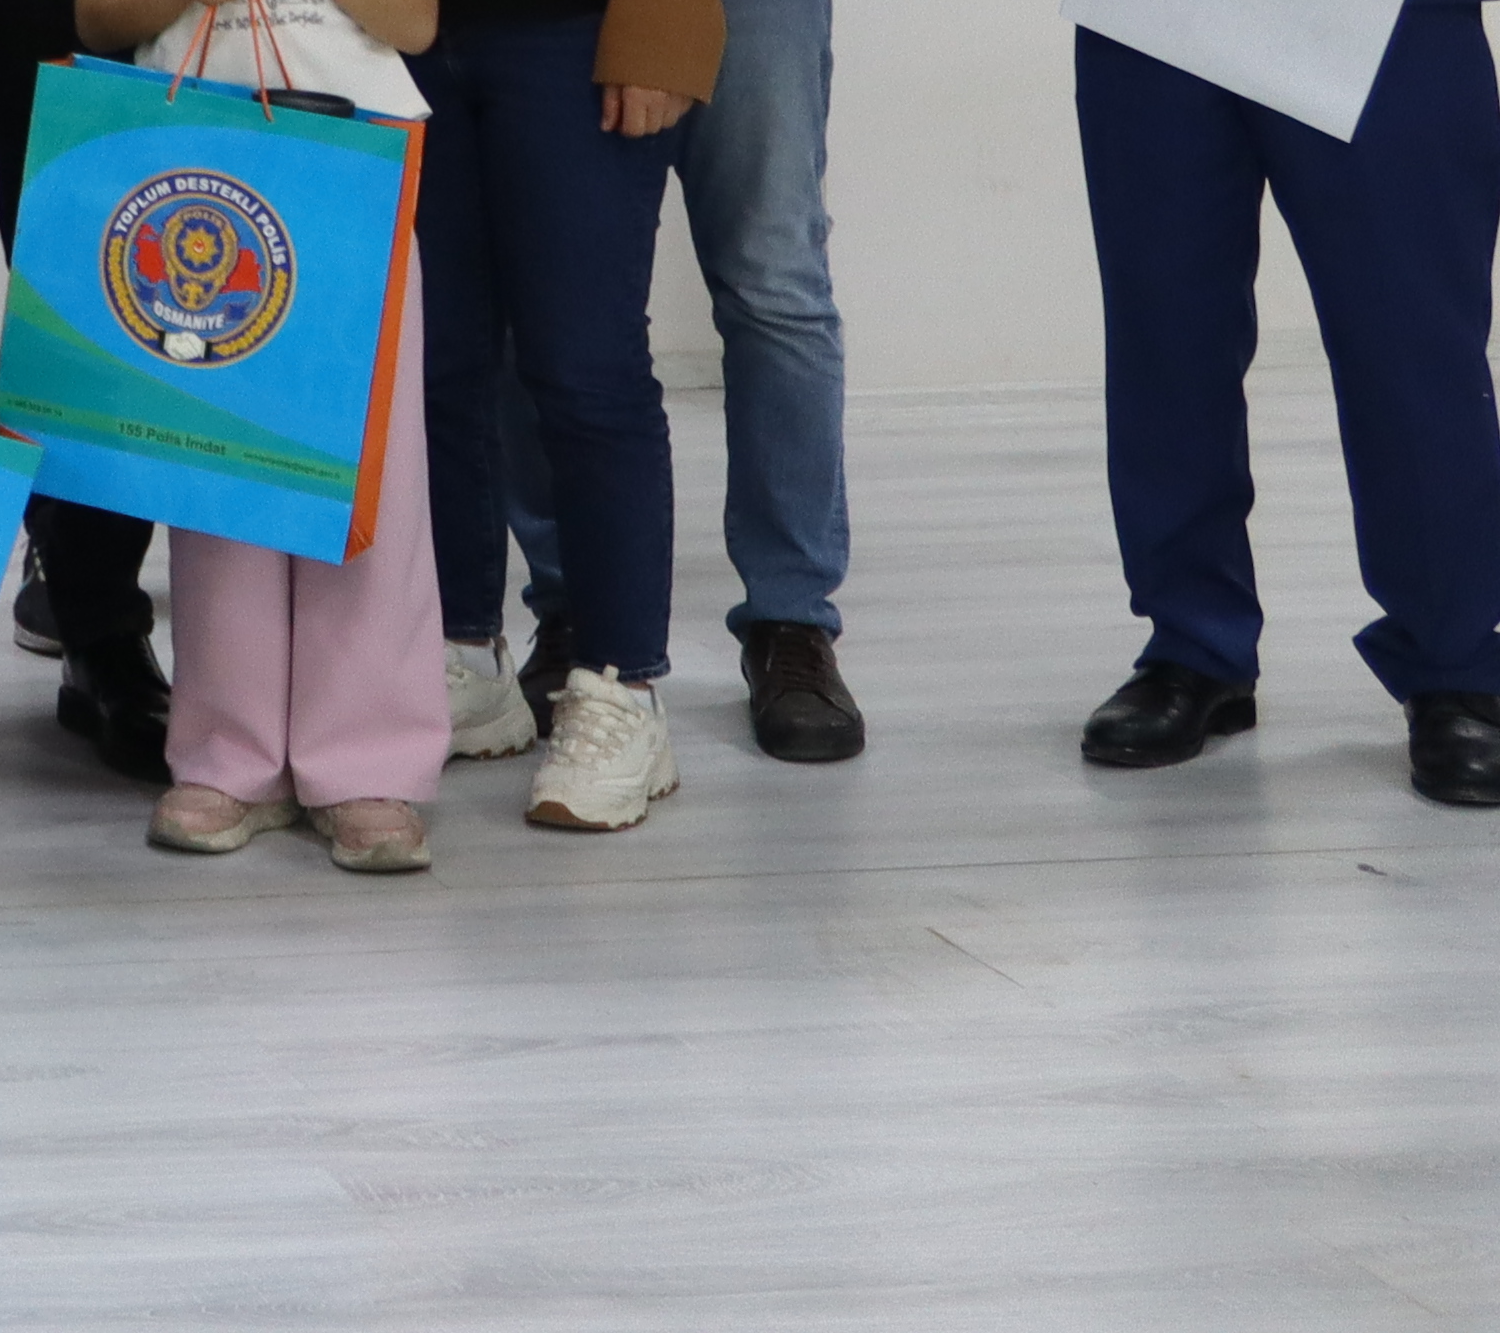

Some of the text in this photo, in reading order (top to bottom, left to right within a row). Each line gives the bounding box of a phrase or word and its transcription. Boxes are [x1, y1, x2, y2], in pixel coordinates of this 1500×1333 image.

[114, 176, 288, 267] TOPLUM DESTEKLİ POLİS
[152, 301, 226, 331] OSMANİYE
